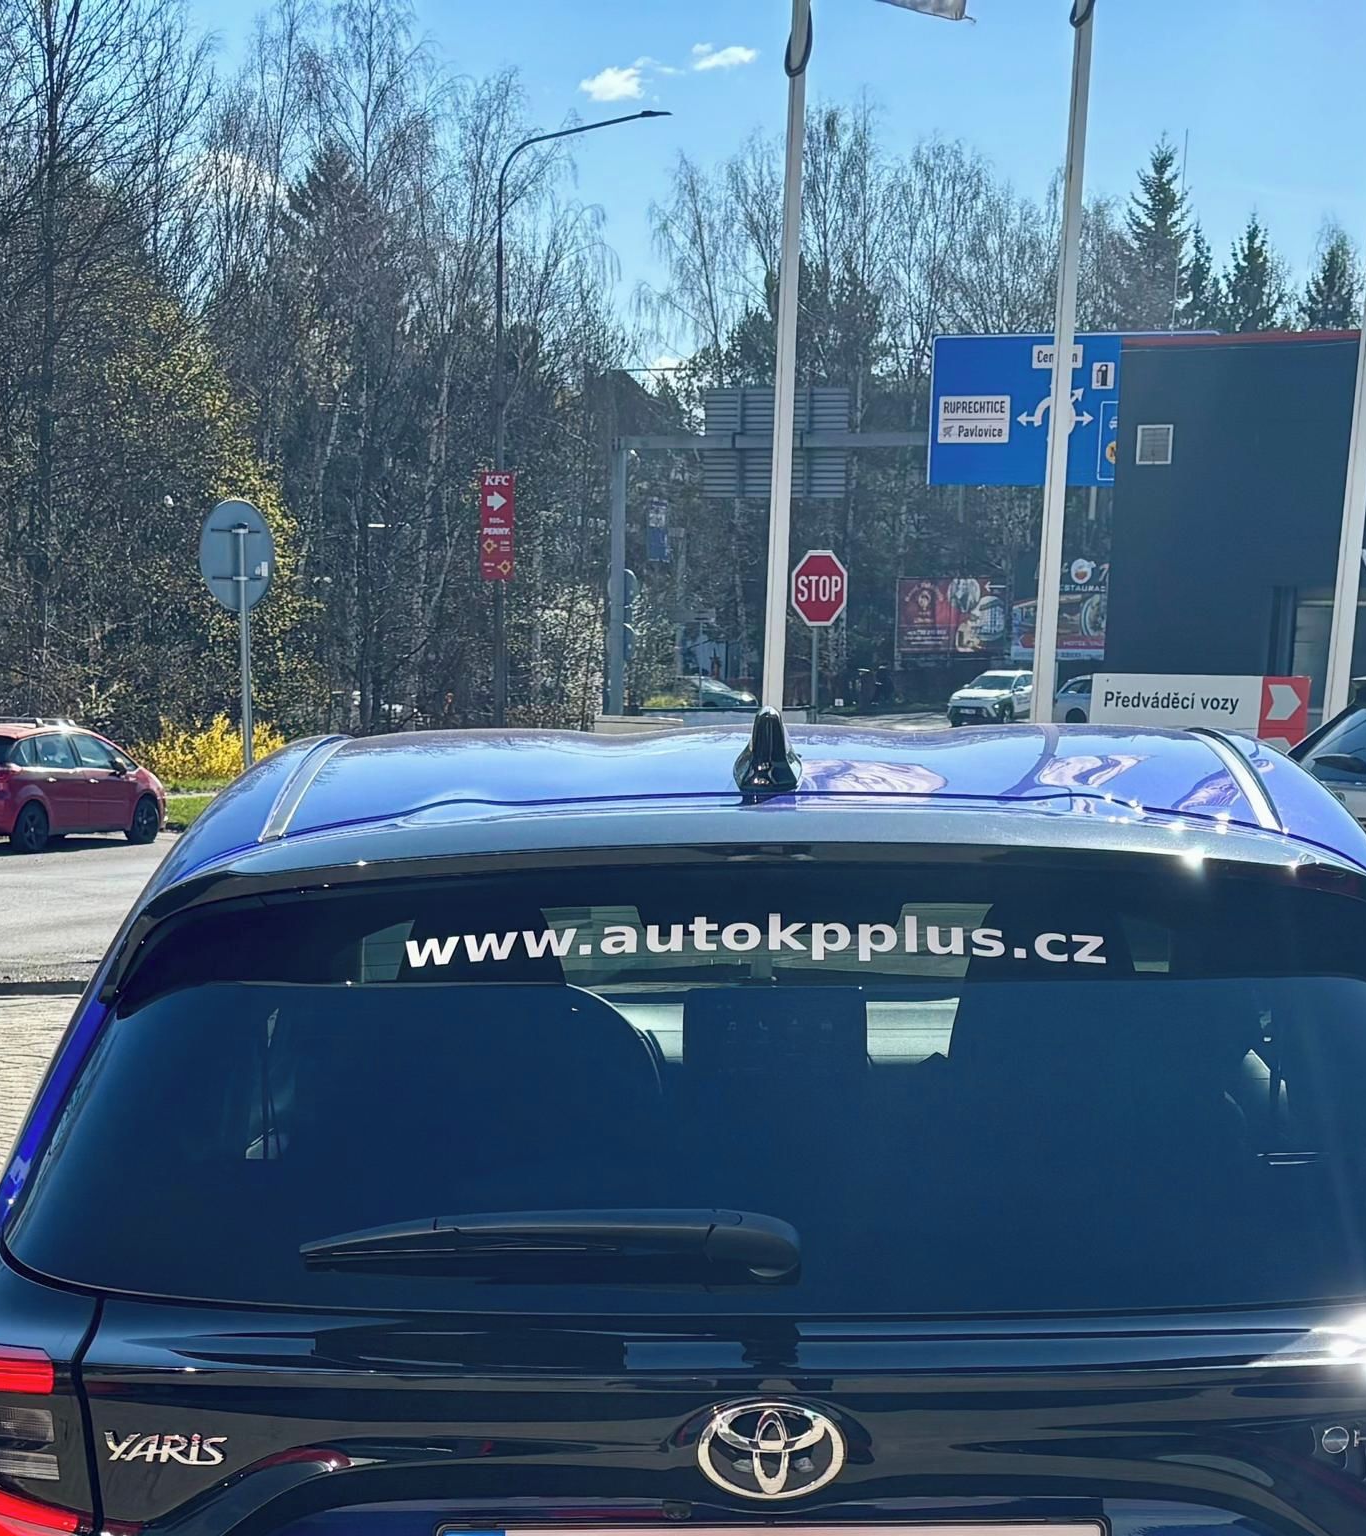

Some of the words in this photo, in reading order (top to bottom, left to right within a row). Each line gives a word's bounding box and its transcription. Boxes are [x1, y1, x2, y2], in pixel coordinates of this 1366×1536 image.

[1037, 350, 1078, 363] Cenm
[943, 400, 1006, 414] RUPRECHTICE
[957, 425, 1003, 438] Pavlovice
[484, 475, 510, 486] KFC
[797, 575, 842, 602] STOP
[1103, 691, 1196, 710] Předváděcí
[1200, 696, 1239, 715] vozy
[405, 912, 1107, 967] www.autokpplus.cz
